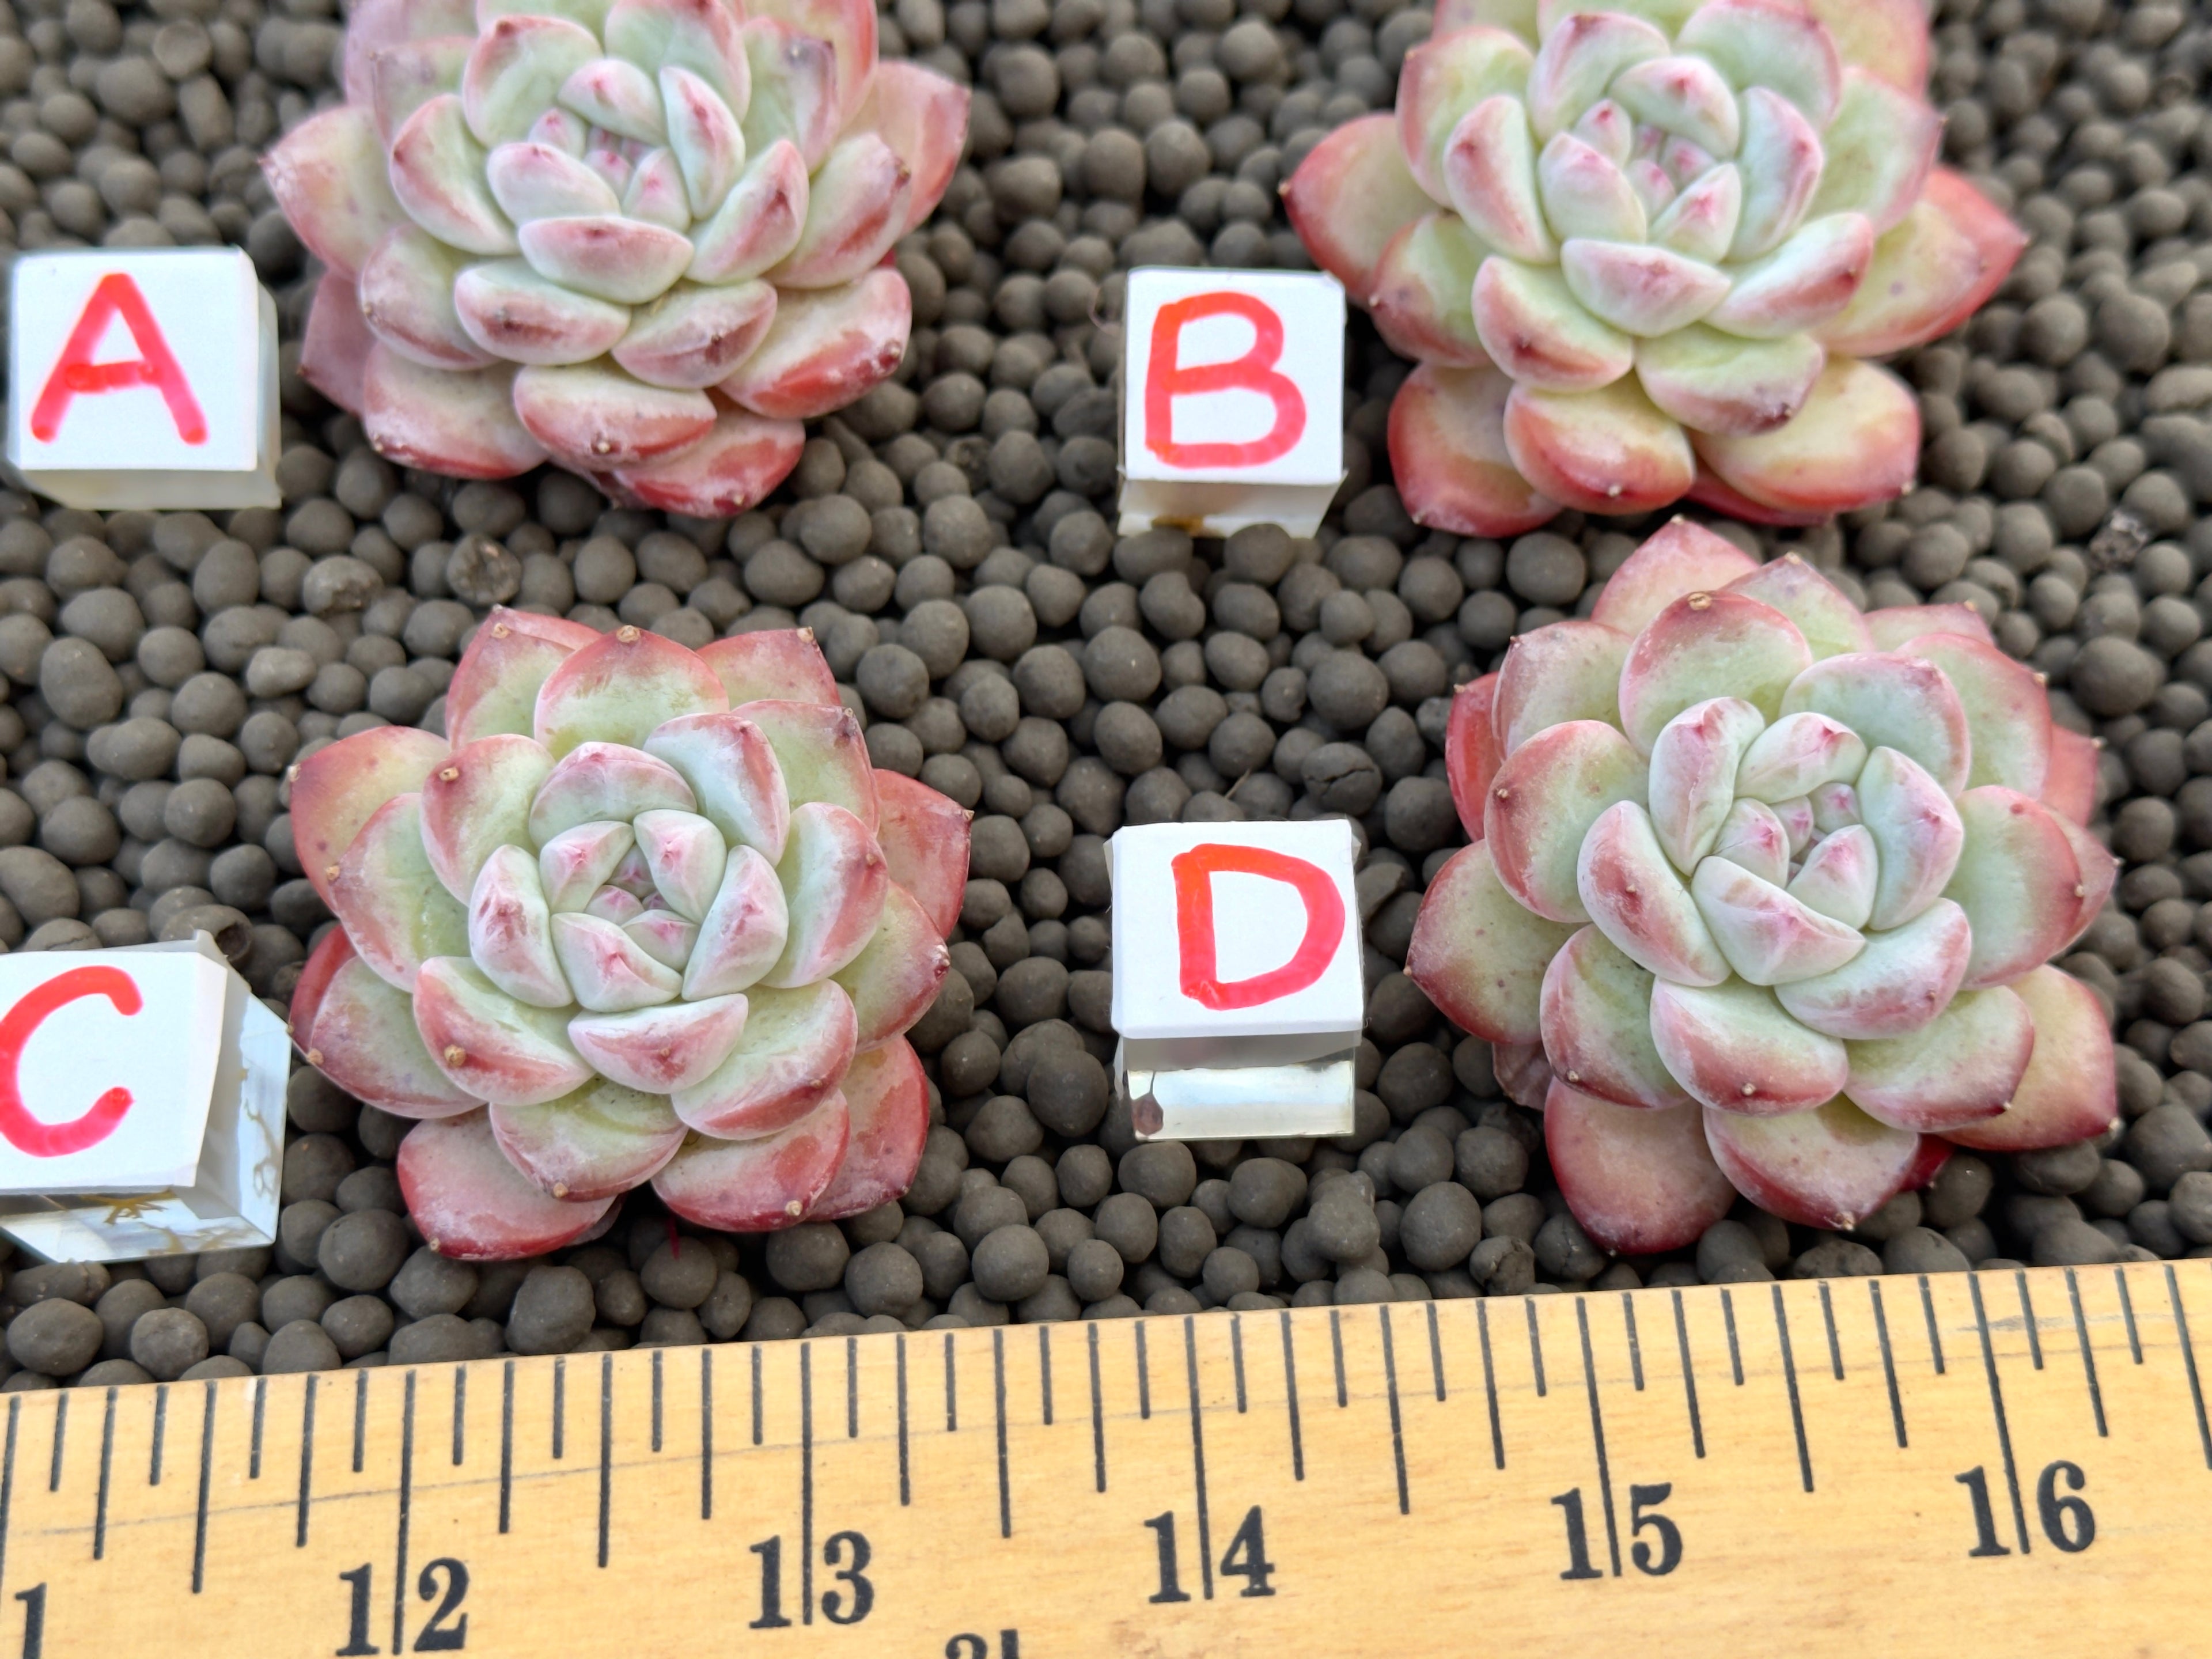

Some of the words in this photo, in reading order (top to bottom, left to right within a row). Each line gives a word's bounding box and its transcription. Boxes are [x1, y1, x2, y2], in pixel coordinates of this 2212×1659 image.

[30, 272, 209, 446] A
[1145, 290, 1306, 470] B
[1171, 843, 1346, 1011] D
[0, 965, 143, 1158] C
[1144, 1506, 1276, 1604] 14
[1551, 1483, 1683, 1580] 15
[1956, 1460, 2096, 1558] 16
[336, 1558, 469, 1657] 12
[749, 1531, 874, 1630] 13
